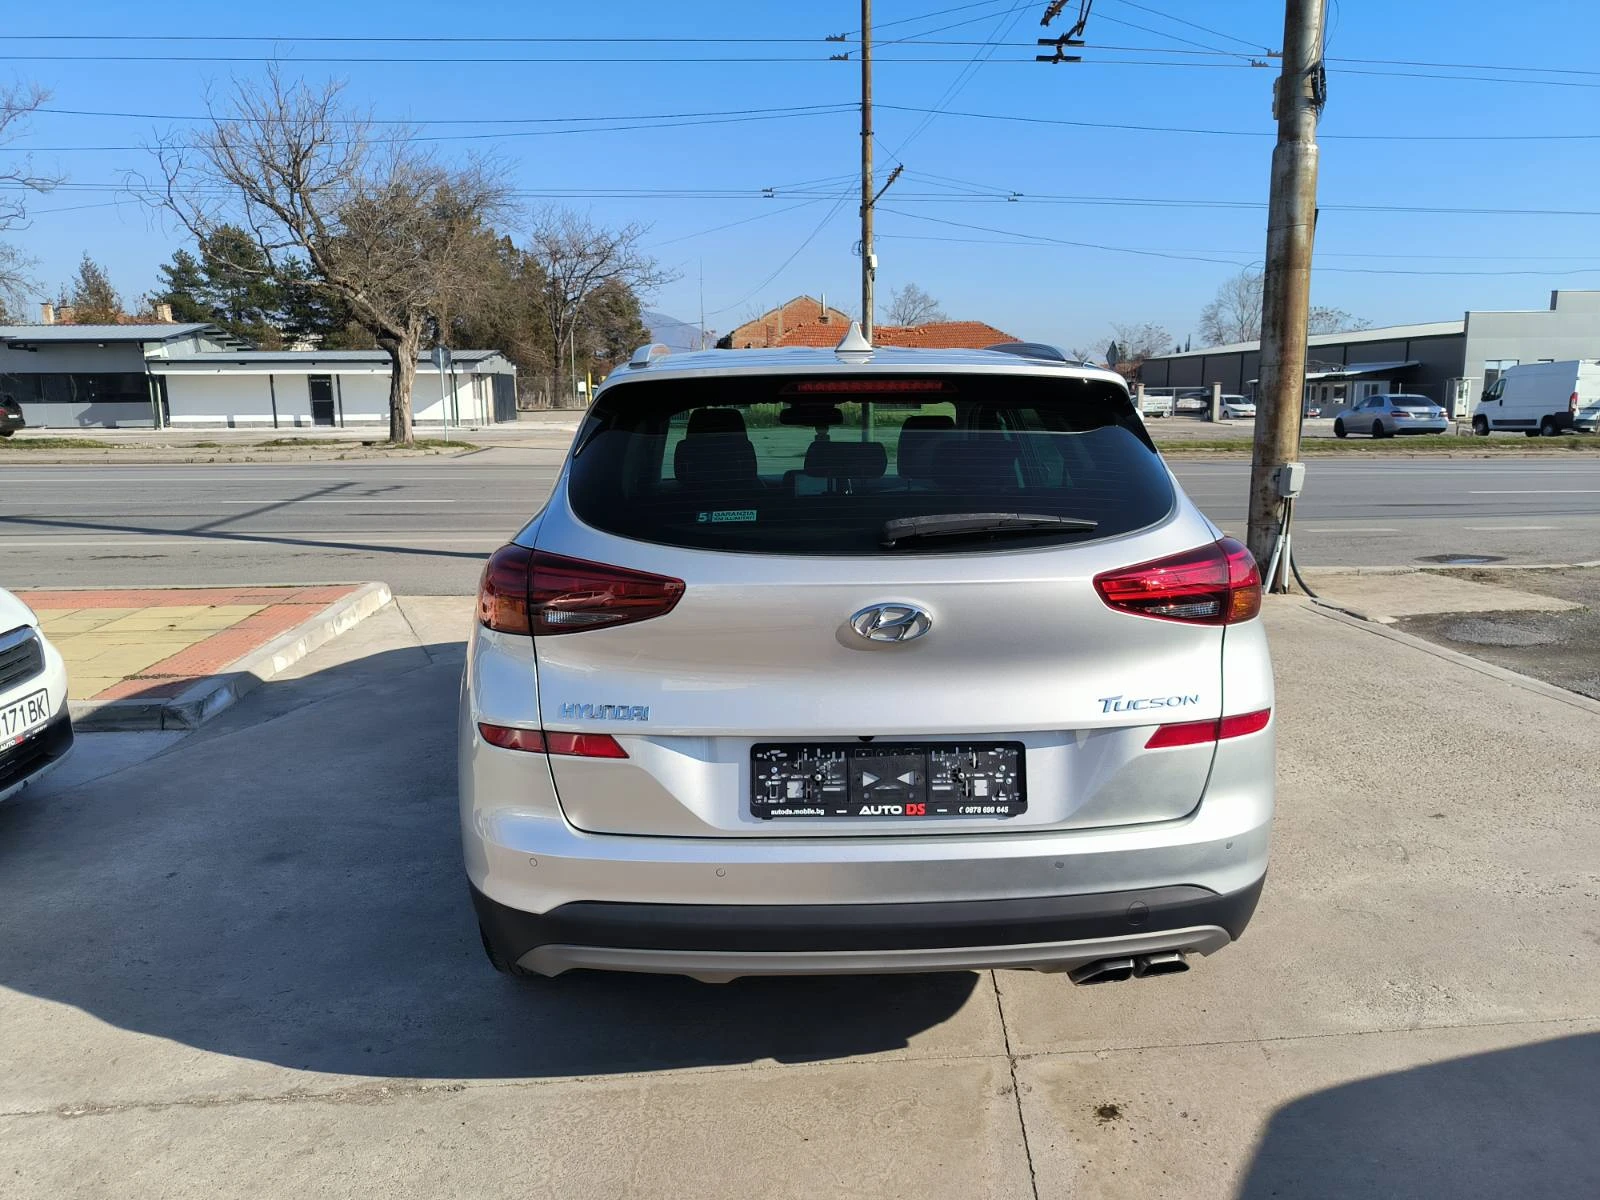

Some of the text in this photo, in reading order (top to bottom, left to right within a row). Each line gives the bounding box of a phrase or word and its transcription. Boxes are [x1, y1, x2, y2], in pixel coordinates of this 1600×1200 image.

[0, 704, 26, 736] 171
[560, 702, 650, 721] HYUNDAI
[770, 808, 825, 816] autods.mobile.bg
[859, 805, 902, 815] AUTO
[905, 803, 926, 816] DS
